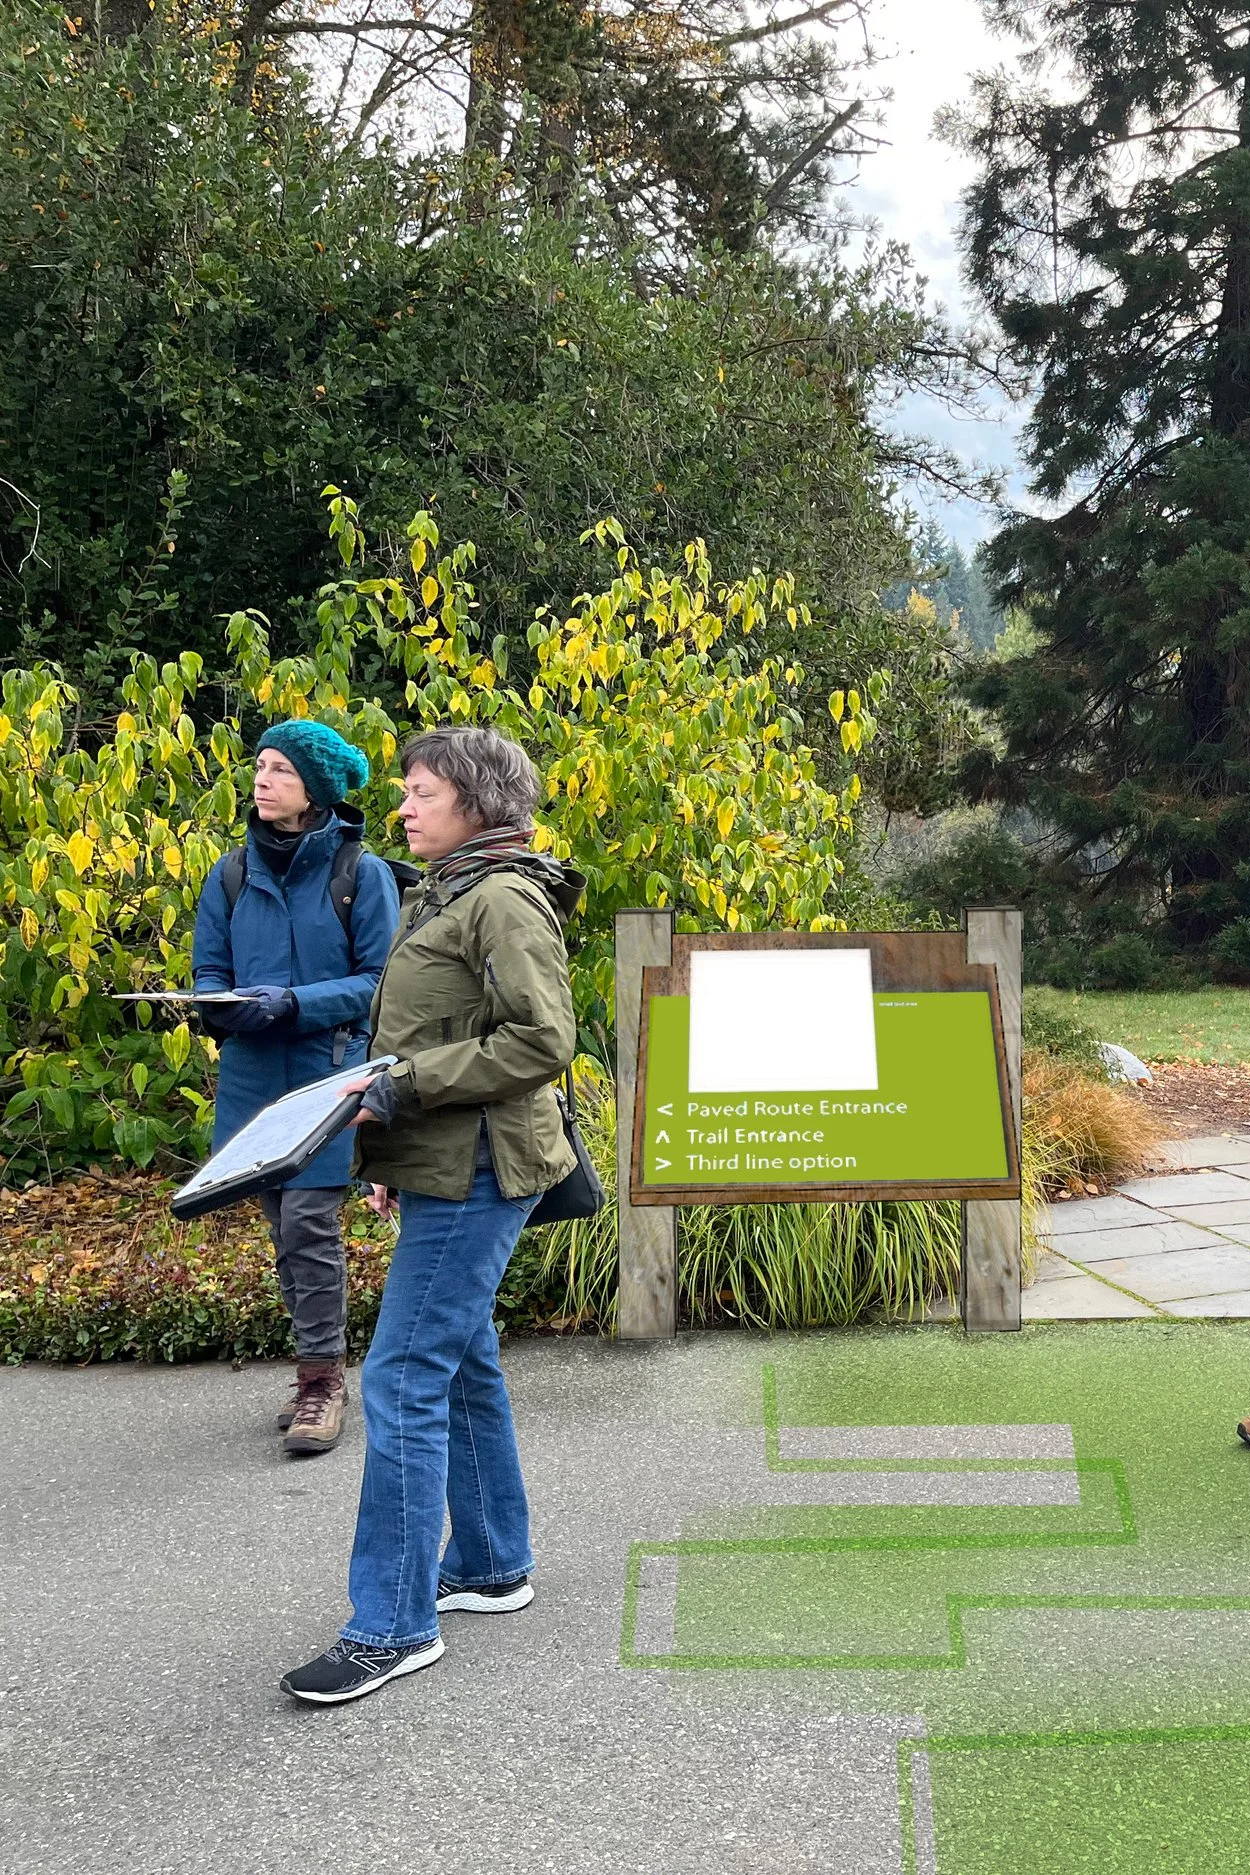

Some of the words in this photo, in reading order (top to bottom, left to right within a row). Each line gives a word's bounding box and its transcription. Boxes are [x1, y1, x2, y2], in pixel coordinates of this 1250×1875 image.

[688, 1101, 748, 1117] Paved
[754, 1101, 814, 1116] Route
[820, 1100, 908, 1116] Entrance
[687, 1128, 728, 1144] Trail
[735, 1128, 825, 1144] Entrance
[686, 1154, 739, 1170] Third
[746, 1153, 784, 1169] line
[789, 1153, 858, 1172] option
